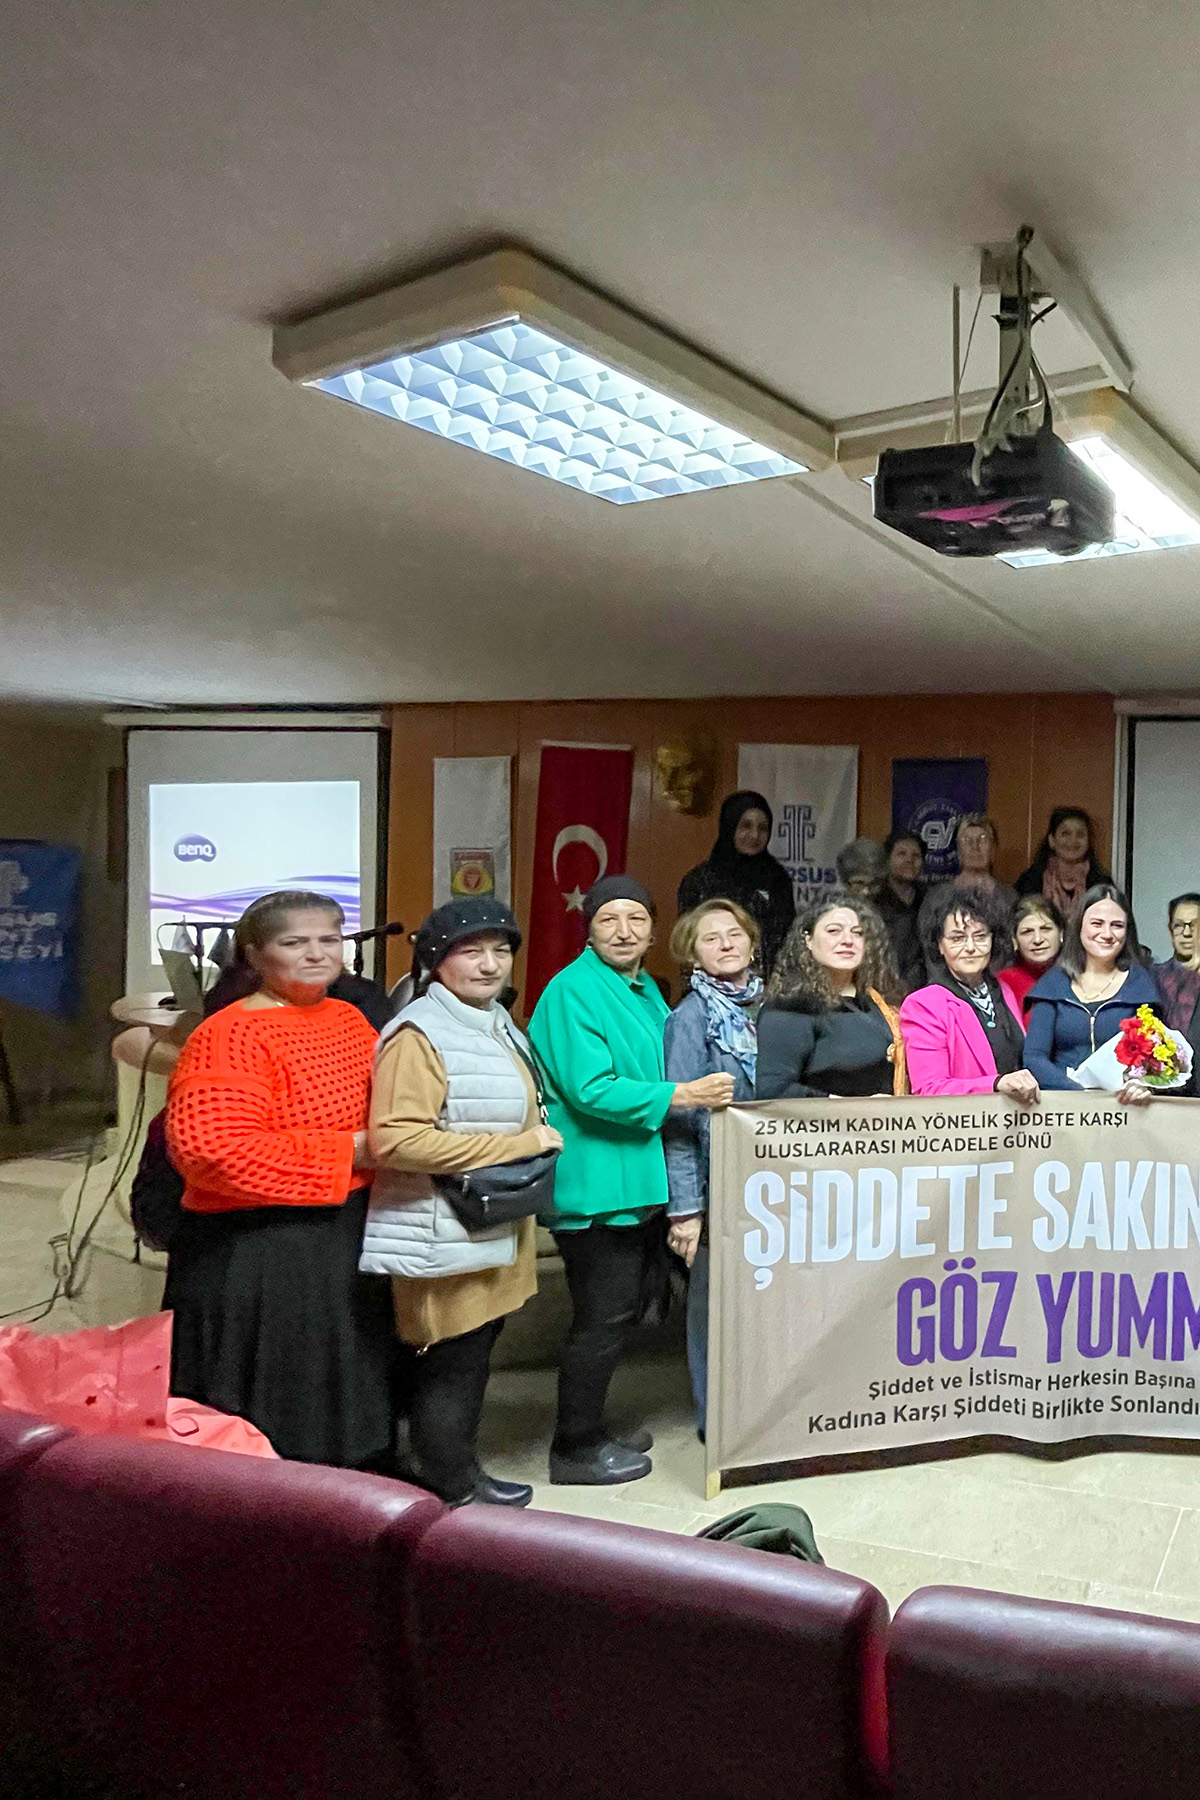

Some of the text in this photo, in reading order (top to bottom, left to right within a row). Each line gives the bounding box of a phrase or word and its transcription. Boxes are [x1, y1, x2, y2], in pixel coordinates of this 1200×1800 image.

[755, 1110, 1128, 1135] 25 KASIM KADINA YÖNELİK ŞİDDETE KARŞI
[755, 1132, 1052, 1159] ULUSLARARASI MÜCADELE GÜNÜ
[743, 1161, 1014, 1290] ŞİDDETE
[896, 1256, 1018, 1367] GÖZ
[868, 1375, 935, 1400] Şiddet
[940, 1375, 963, 1390] ve
[969, 1367, 1042, 1391] İstismar
[1047, 1368, 1129, 1391] Herkesin
[1134, 1369, 1196, 1390] Başına
[808, 1411, 886, 1434] Kadına
[893, 1403, 947, 1424] Karşı
[953, 1394, 1026, 1419] Şiddeti
[1031, 1397, 1104, 1420] Birlikte
